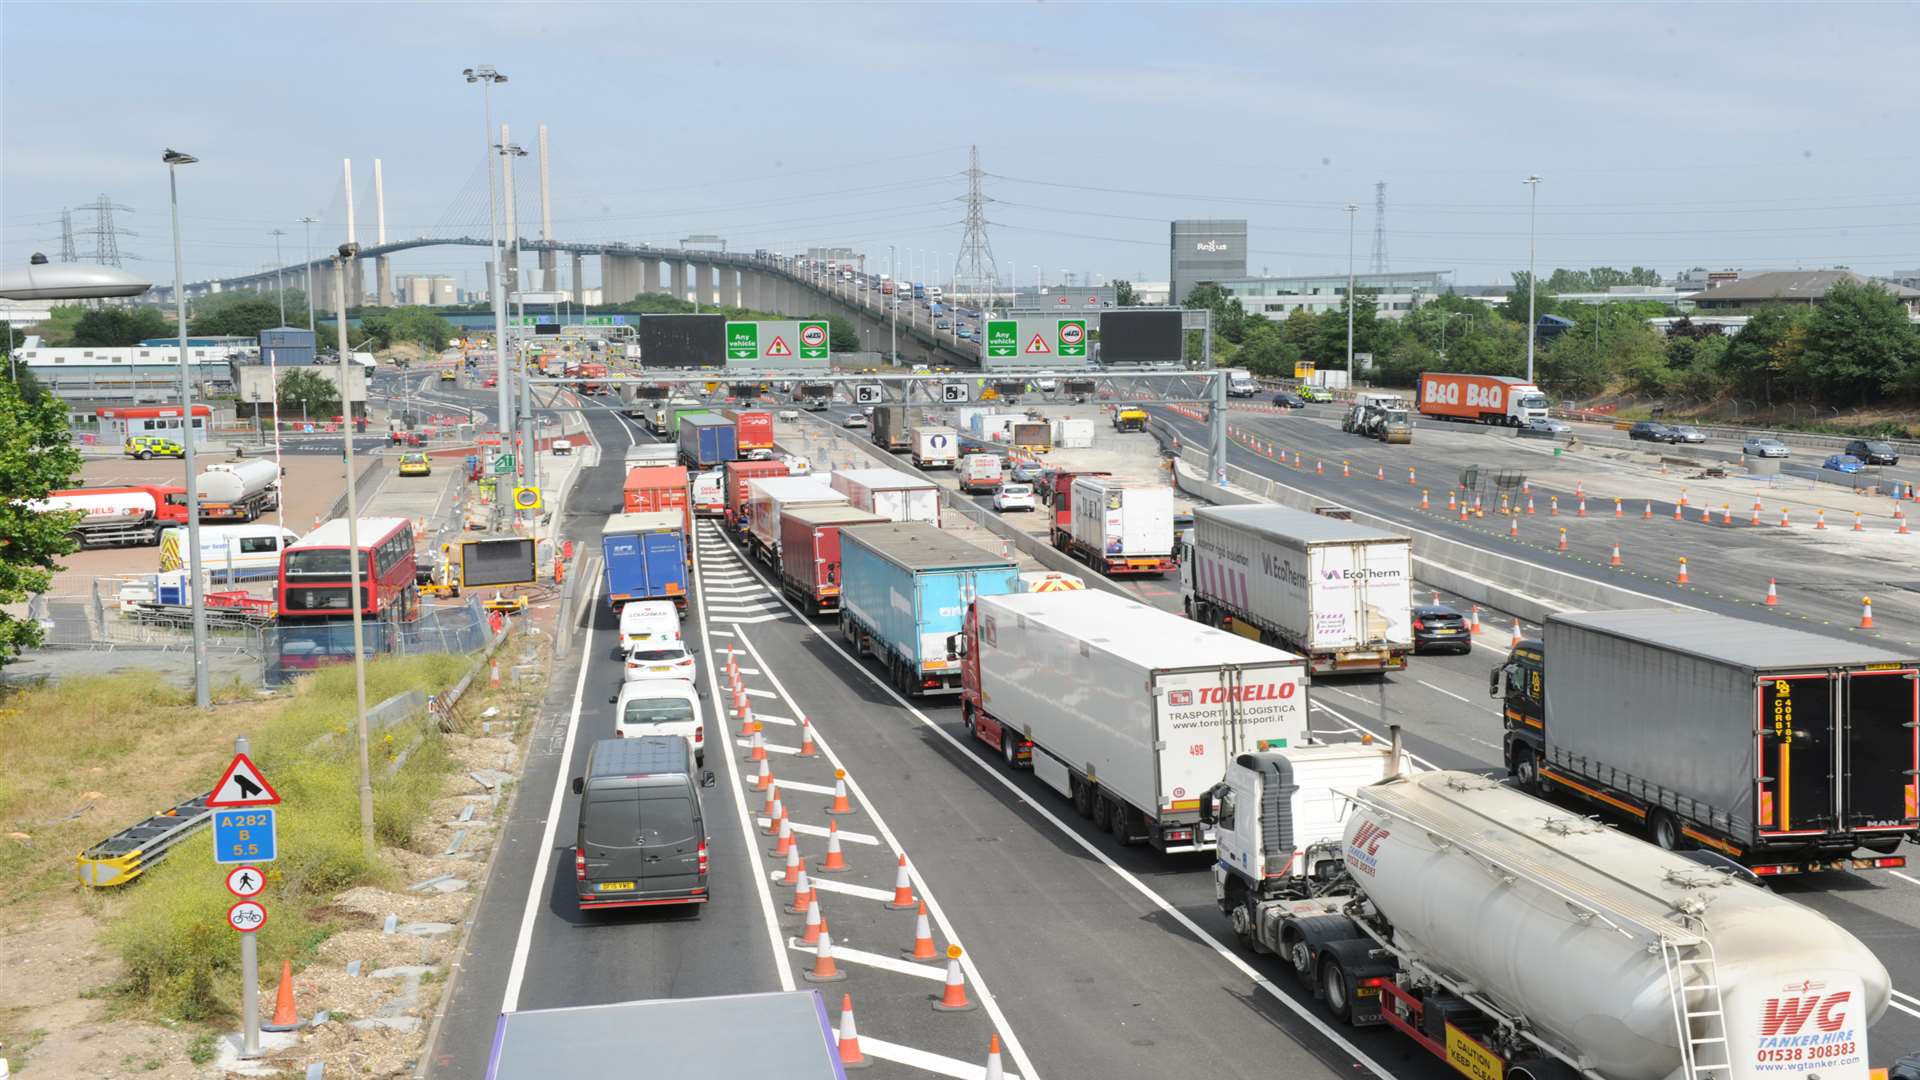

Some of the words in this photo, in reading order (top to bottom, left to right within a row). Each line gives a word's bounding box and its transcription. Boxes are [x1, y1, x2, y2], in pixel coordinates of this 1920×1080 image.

[1196, 240, 1228, 253] Regus
[735, 334, 750, 342] Any
[989, 338, 1016, 346] vehicle
[995, 331, 1010, 340] Any
[1425, 381, 1460, 406] B&Q
[1466, 383, 1503, 409] B&Q
[1273, 555, 1307, 589] EcoTherm
[1343, 567, 1401, 580] EcoTherm
[1198, 682, 1296, 705] TORELLO
[1169, 709, 1229, 721] TRASPORTI
[1243, 704, 1297, 716] LOGISTICA
[1774, 699, 1784, 737] CORBY
[1172, 715, 1285, 729] www.torellotrasporti.it
[1784, 699, 1793, 744] 406183
[222, 816, 233, 828] A
[236, 815, 267, 827] 282
[239, 829, 250, 841] B
[1352, 820, 1390, 856] WG
[232, 844, 259, 856] 5.5
[1758, 991, 1852, 1036] WG
[1759, 1034, 1820, 1048] TANKER
[1821, 1030, 1855, 1047] HIRE
[1450, 1049, 1470, 1067] KEEP
[1457, 1039, 1491, 1069] CAUTION
[1757, 1048, 1803, 1062] 01538
[1807, 1041, 1856, 1060] 308383
[1755, 1056, 1861, 1072] www.wgtanker.com
